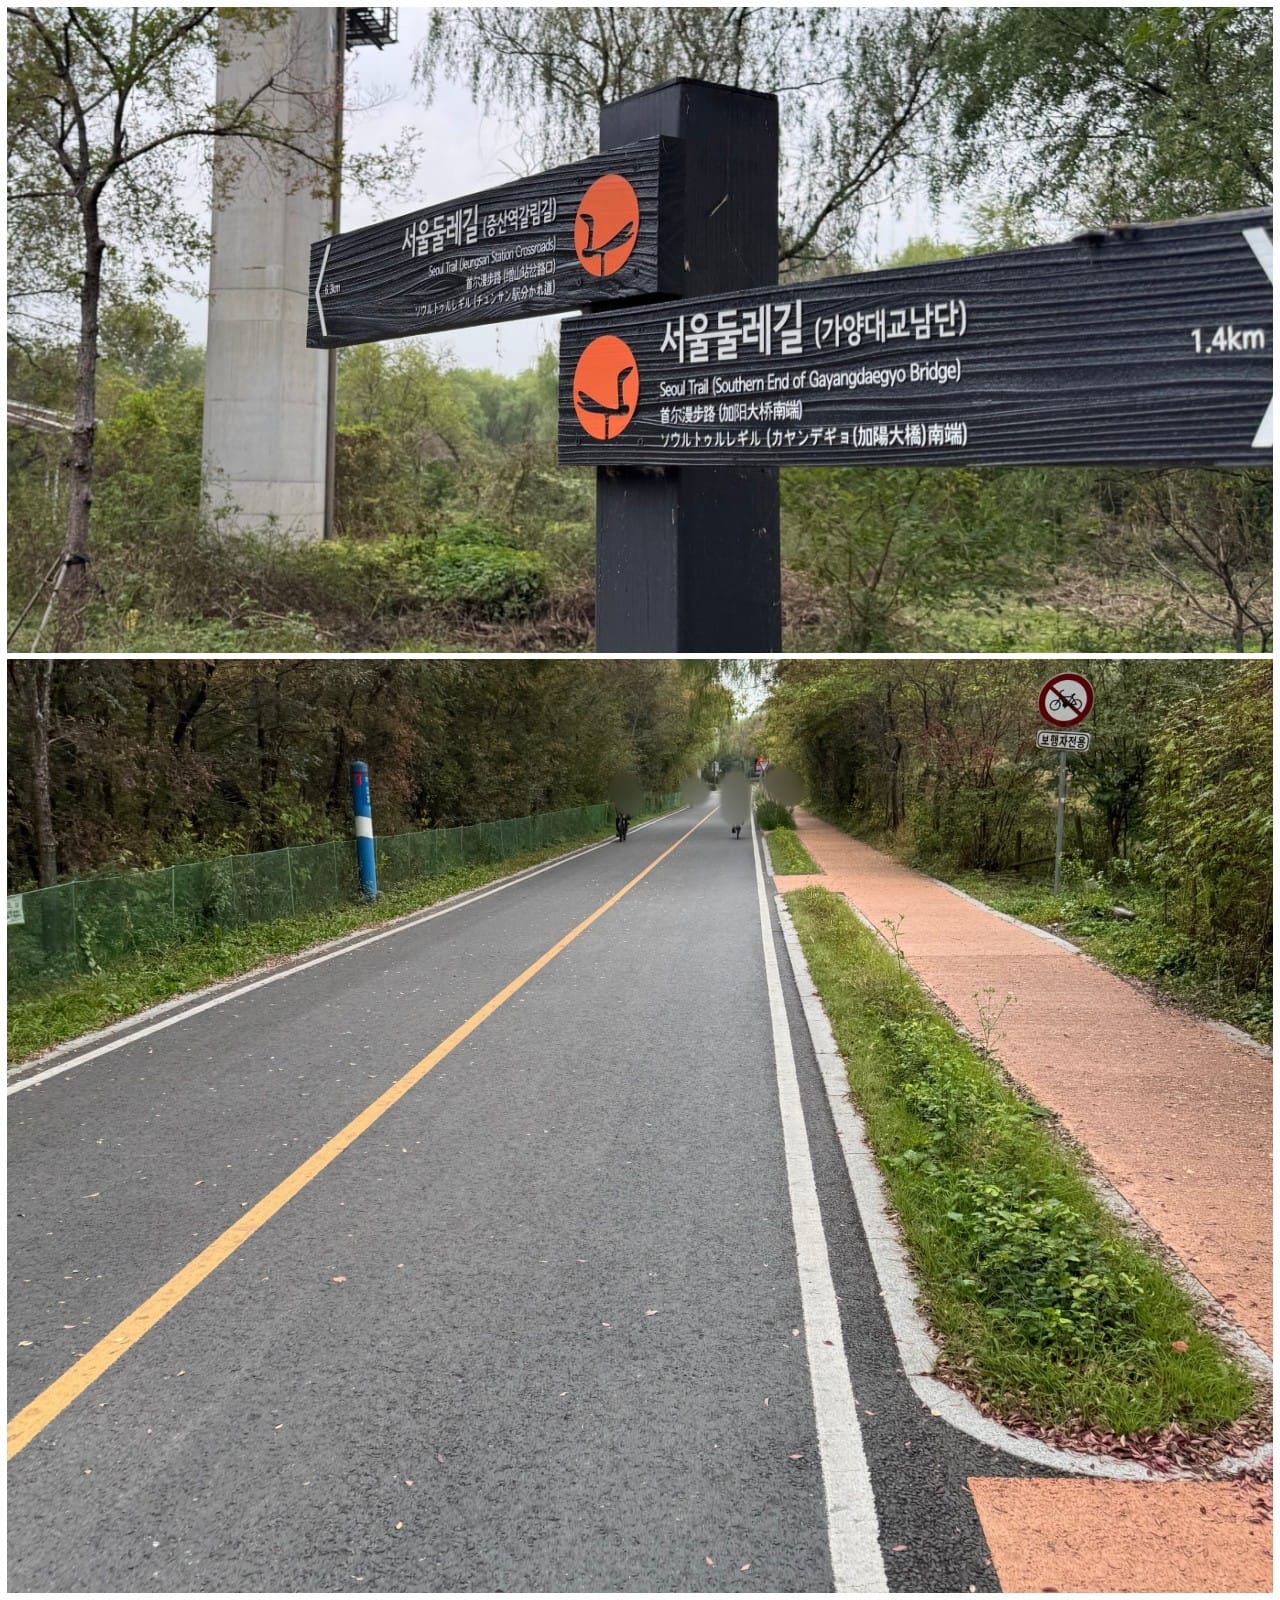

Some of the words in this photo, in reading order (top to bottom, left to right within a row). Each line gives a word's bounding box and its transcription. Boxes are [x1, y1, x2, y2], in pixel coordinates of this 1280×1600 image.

[402, 204, 478, 257] 서울둘레길
[483, 197, 557, 238] (증산역갈림길)
[429, 265, 444, 277] Seoul
[446, 260, 457, 272] Trail
[459, 255, 490, 273] (Jeungsan
[491, 249, 513, 264] Station
[515, 236, 556, 258] Crossroads)
[660, 299, 803, 364] 서울둘레길
[815, 299, 967, 349] (가양대교남단)
[1191, 326, 1265, 354] 1.4km
[660, 381, 686, 398] Seoul
[688, 379, 709, 396] Trail
[712, 375, 764, 397] (Southern
[768, 372, 789, 391] End
[792, 371, 806, 389] of
[809, 367, 906, 393] Gayangdaegyo
[910, 358, 961, 383] Bridge)
[660, 405, 715, 424] 首尔漫步路
[719, 400, 802, 423] (加阳大桥南端)
[661, 429, 761, 448] ソウルトゥルレギル
[1041, 734, 1086, 748] 보행자전용
